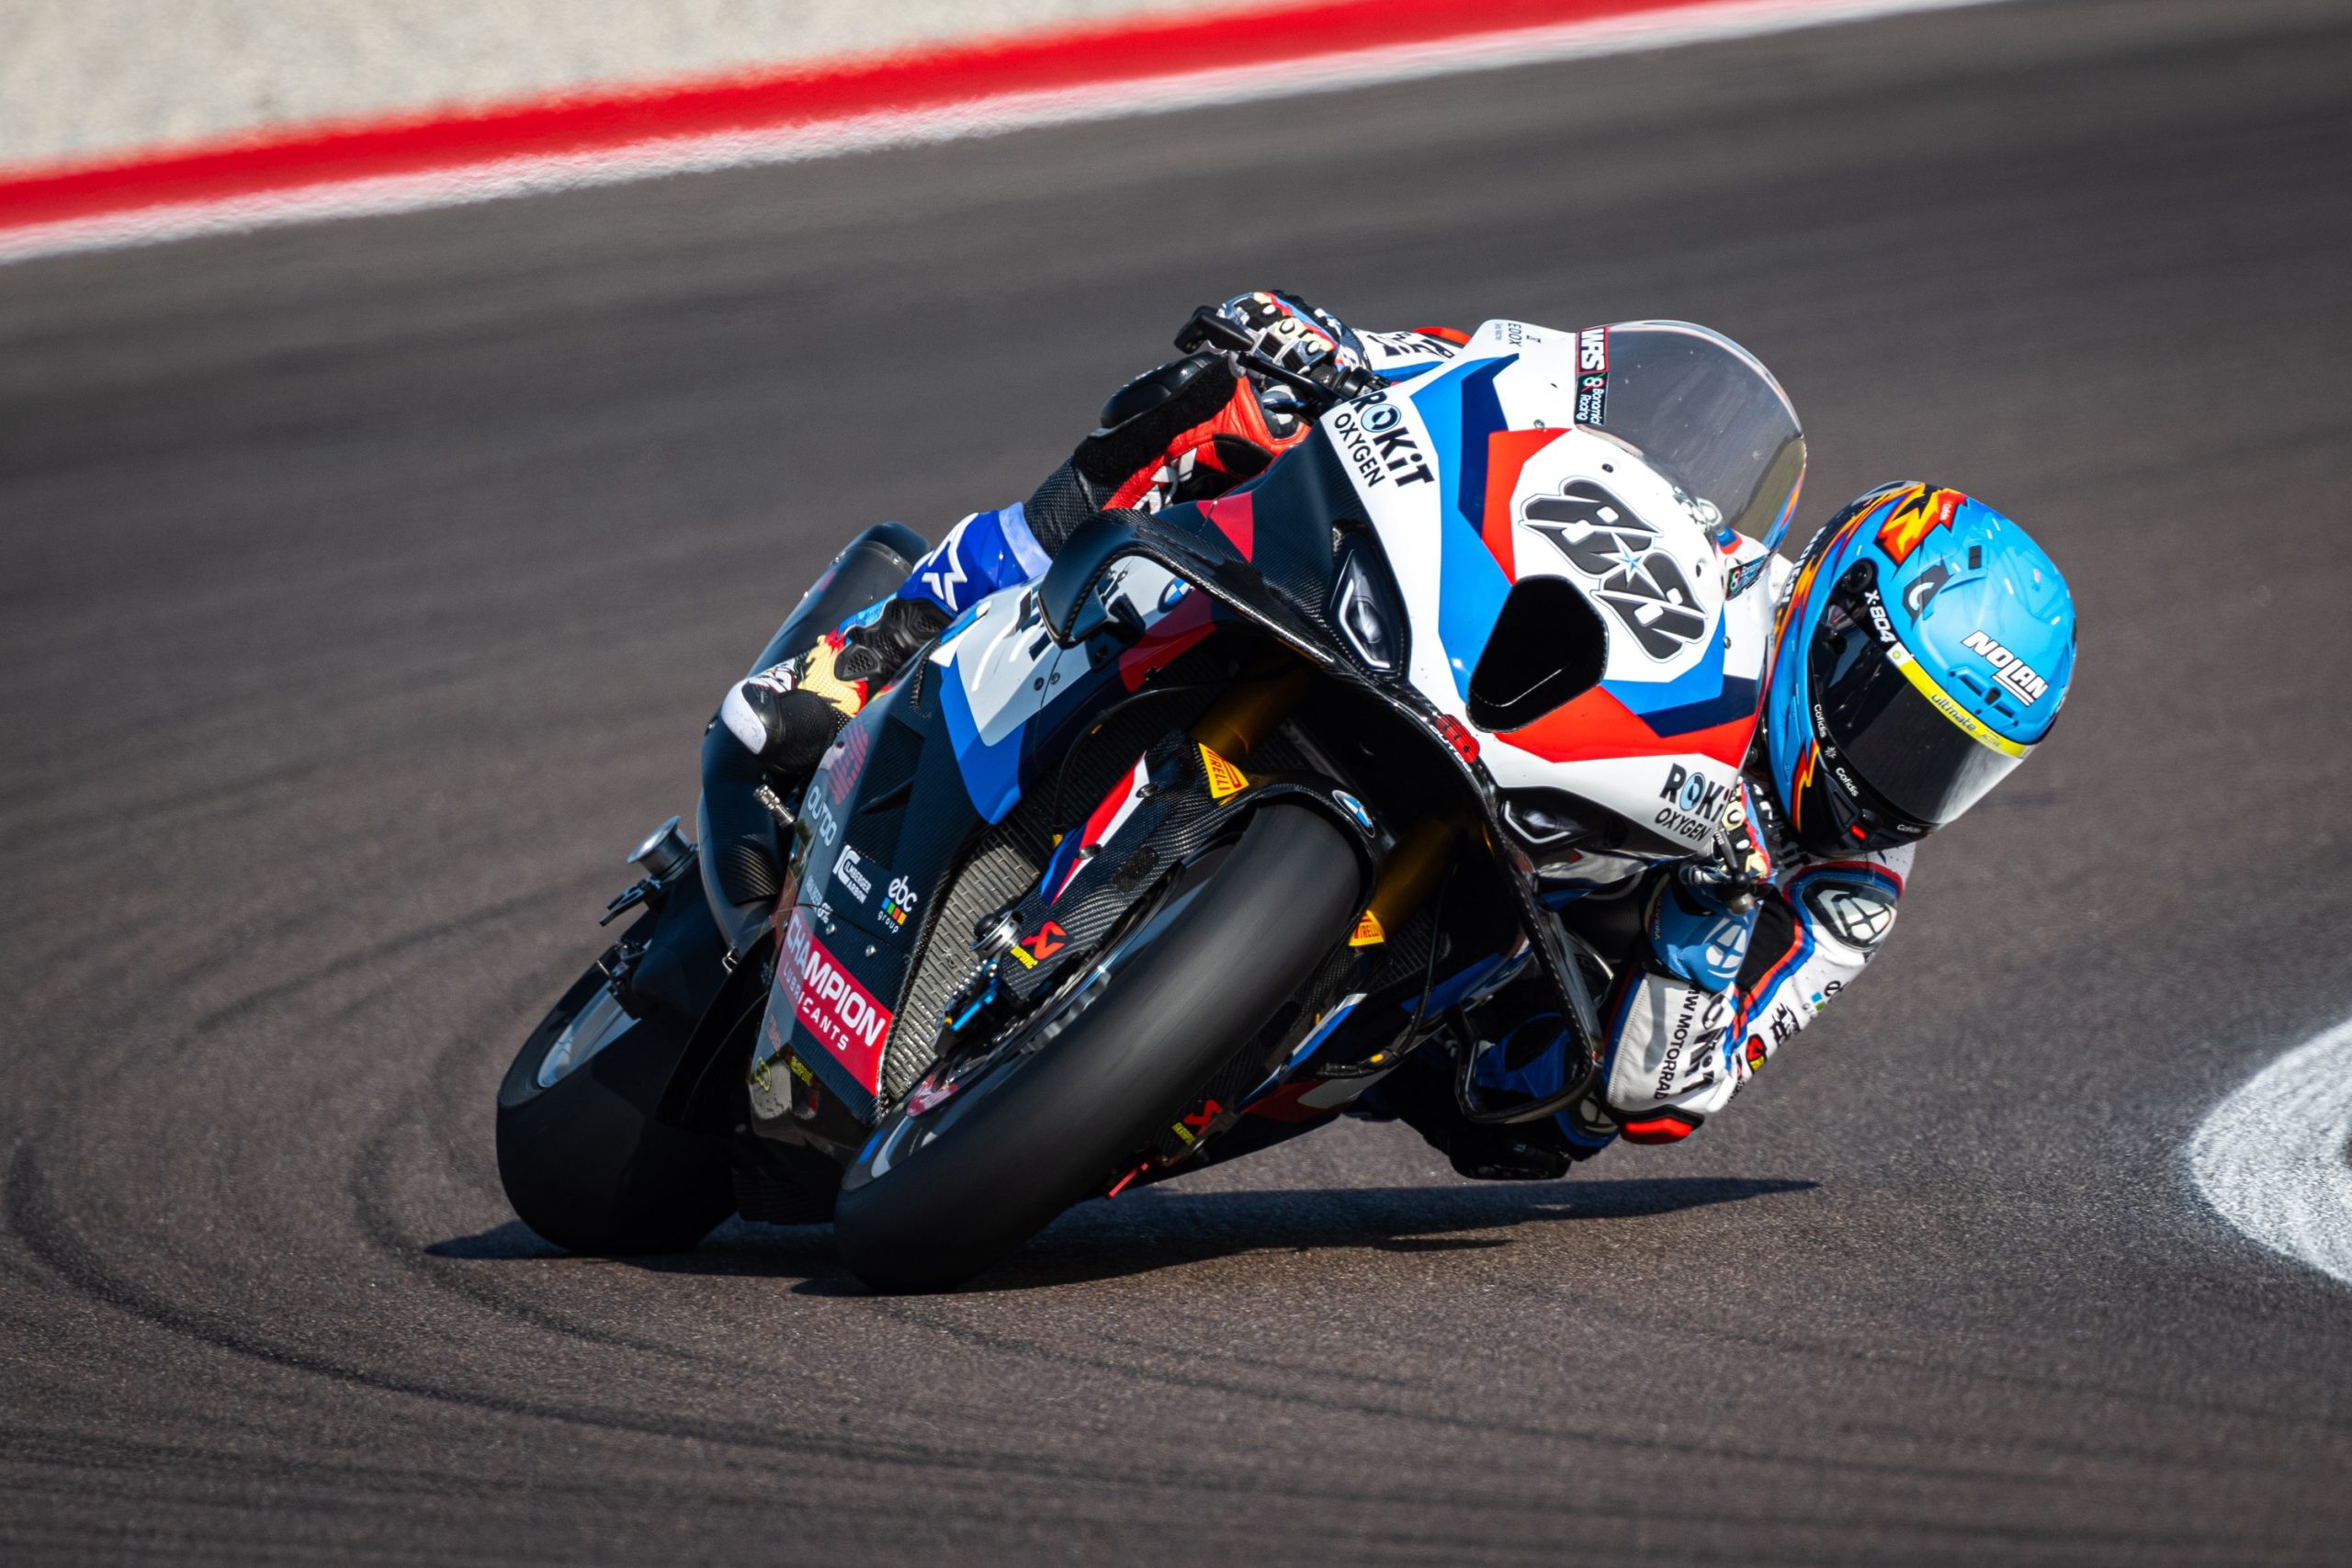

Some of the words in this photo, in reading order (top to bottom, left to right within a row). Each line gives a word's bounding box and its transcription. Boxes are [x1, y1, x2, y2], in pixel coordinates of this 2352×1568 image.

[1508, 323, 1521, 347] EDOX
[1580, 328, 1605, 370] WRS
[1576, 394, 1591, 421] Racing
[1334, 412, 1385, 488] OXYGEN
[1960, 630, 2049, 706] NOLAN
[1814, 704, 1826, 739] Cofidis
[1931, 694, 1976, 730] ultimate
[1836, 767, 1860, 797] Cofidis
[808, 785, 837, 847] OUTDO
[1655, 807, 1711, 842] OXYGEN
[888, 875, 918, 912] ebc
[877, 910, 899, 933] group
[786, 914, 886, 1047] CHAMPION
[784, 962, 850, 1051] LUBRICANTS
[1654, 1013, 1692, 1100] MOTORRAD
